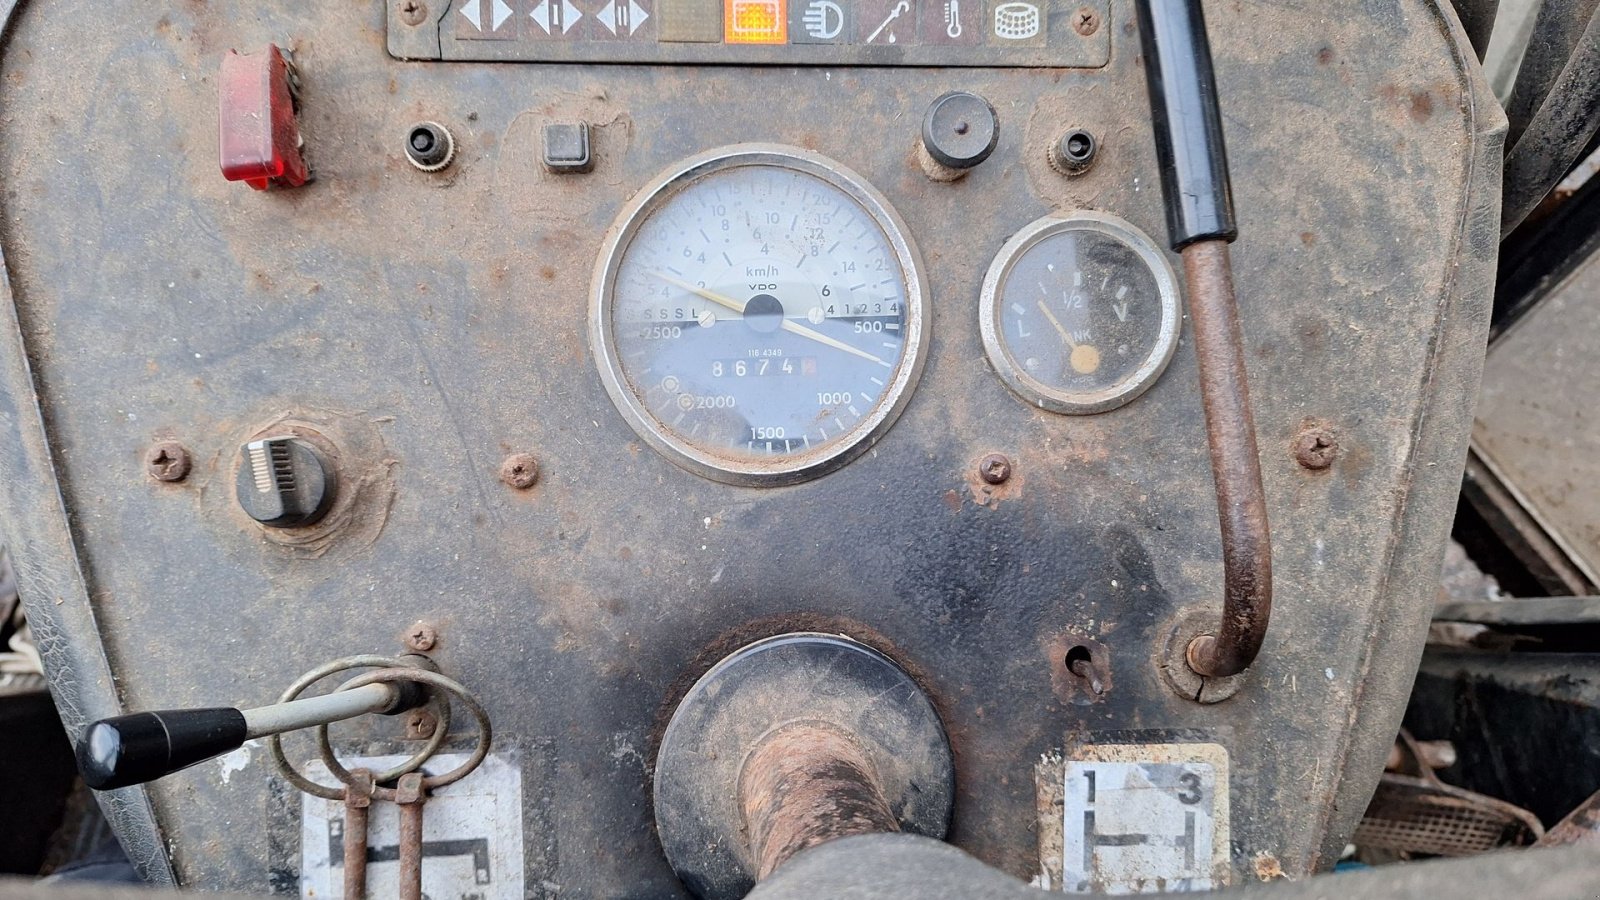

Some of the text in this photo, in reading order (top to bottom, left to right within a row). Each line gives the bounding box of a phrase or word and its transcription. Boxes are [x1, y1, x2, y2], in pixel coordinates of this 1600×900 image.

[813, 194, 830, 206] 20
[712, 205, 726, 216] 10
[765, 212, 780, 224] 10
[816, 213, 831, 225] 15
[721, 219, 730, 231] 8
[752, 228, 762, 241] 6
[683, 246, 693, 258] 6
[760, 243, 769, 255] 4
[810, 245, 820, 257] 8
[696, 252, 706, 264] 4
[746, 264, 779, 278] km/h
[841, 261, 856, 273] 14
[748, 282, 777, 291] VDO
[821, 284, 831, 298] 6
[659, 308, 668, 319] S
[674, 308, 684, 319] S
[827, 303, 898, 315] 4 1 2 3 4
[643, 327, 682, 339] 2500
[854, 321, 882, 334] 500
[1016, 319, 1031, 338] L
[696, 395, 736, 409] 2000
[816, 391, 852, 405] 1000
[750, 426, 785, 440] 1500
[1083, 770, 1096, 803] 1
[1178, 772, 1203, 805] 3
